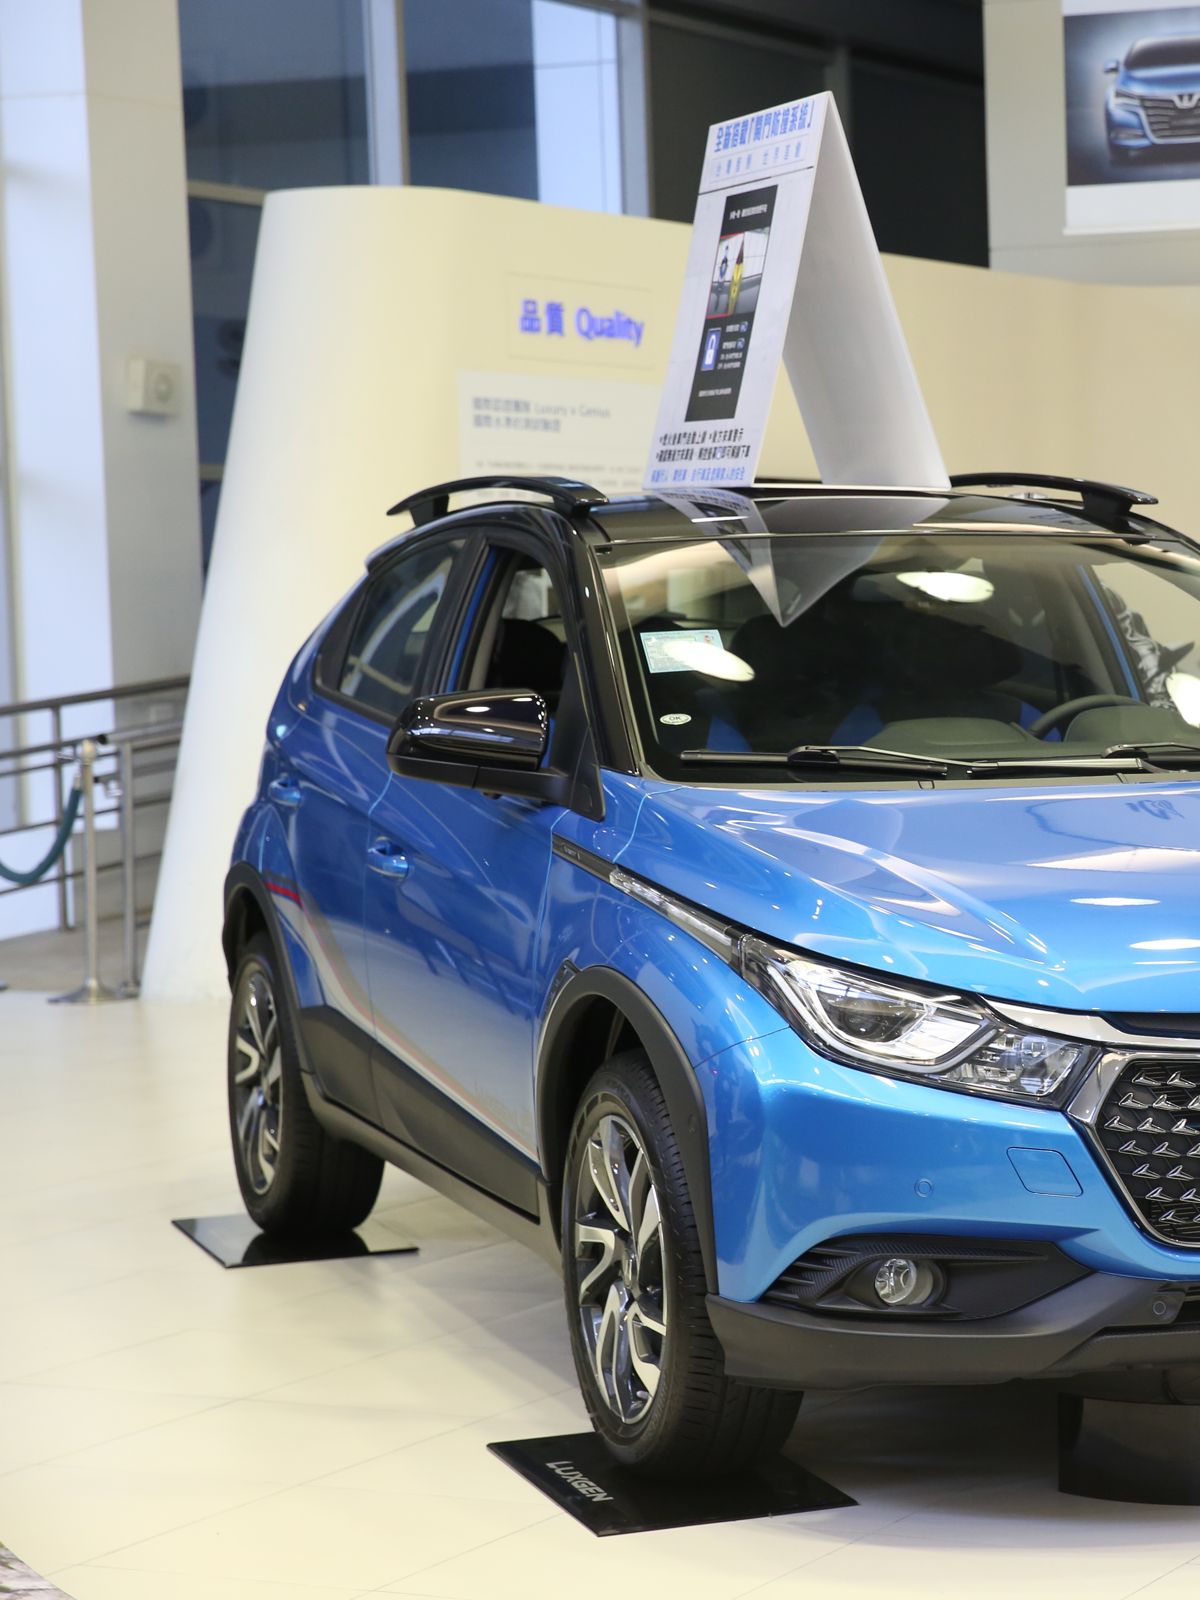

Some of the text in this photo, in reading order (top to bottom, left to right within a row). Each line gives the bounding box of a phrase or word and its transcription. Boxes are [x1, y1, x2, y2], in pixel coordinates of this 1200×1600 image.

[519, 299, 645, 347] 品質 Quality
[545, 1460, 614, 1503] LUXGEN
